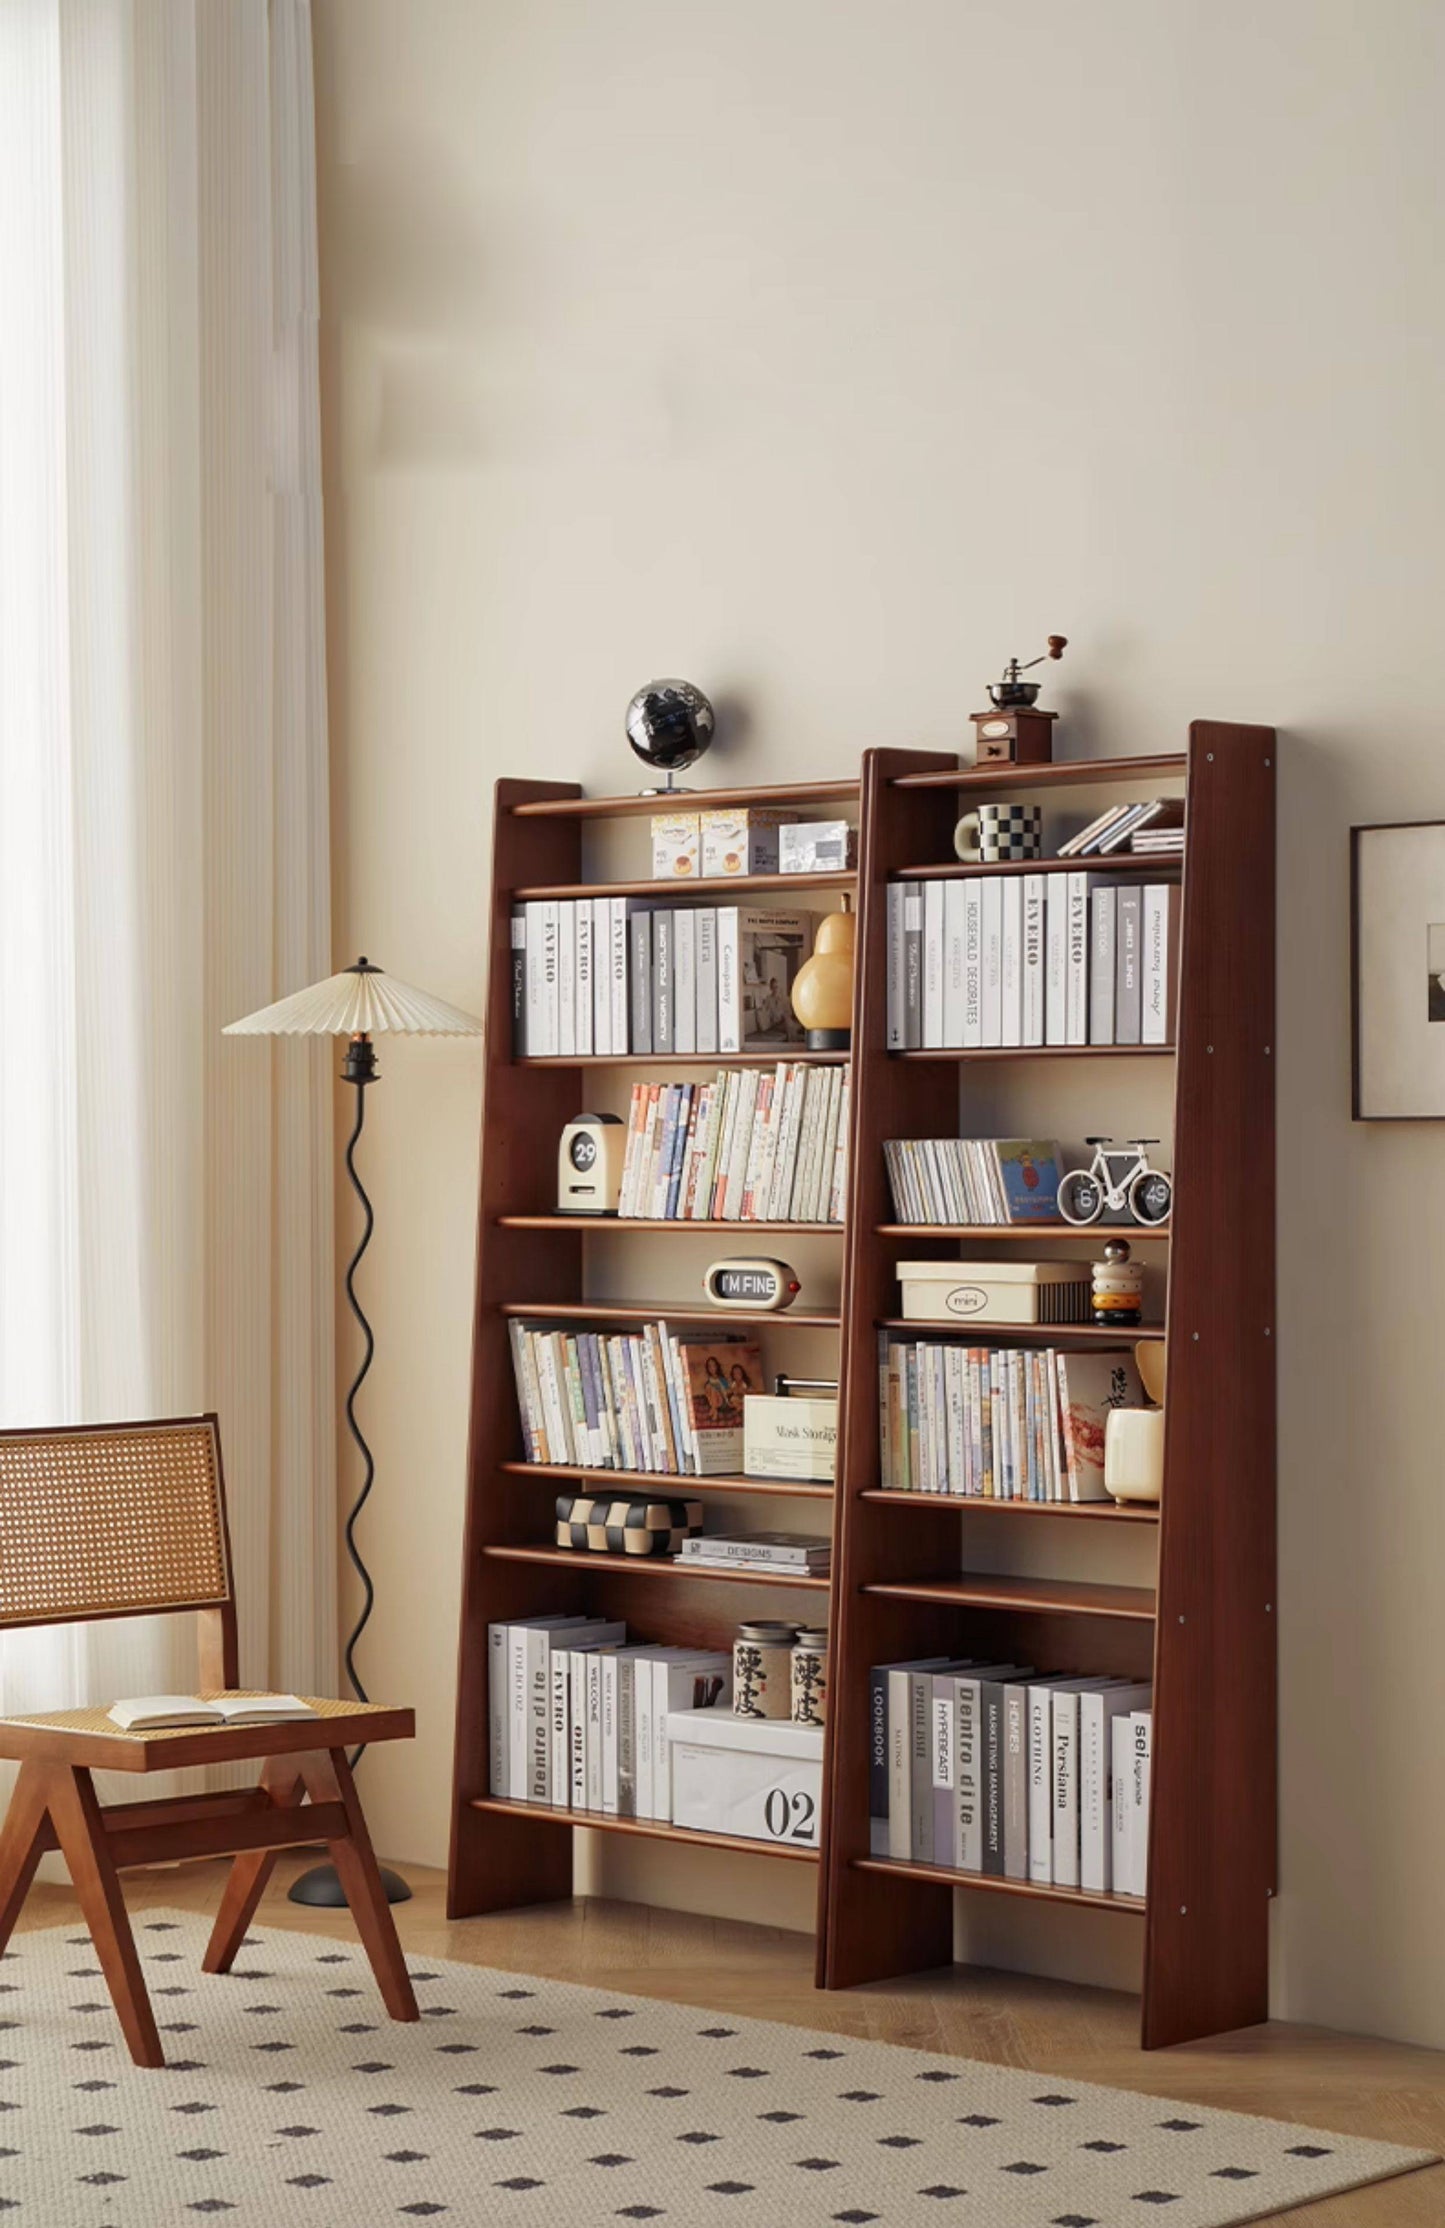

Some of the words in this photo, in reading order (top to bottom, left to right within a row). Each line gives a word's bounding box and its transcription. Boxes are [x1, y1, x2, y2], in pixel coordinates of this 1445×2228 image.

[967, 901, 977, 961] HOUSEHOLD
[1027, 898, 1038, 966] EVERO
[1071, 895, 1082, 965] EVERO
[721, 943, 732, 1005] Company
[966, 966, 977, 1026] DECORATES
[659, 993, 667, 1042] AURORA
[575, 1143, 596, 1162] 29
[1079, 1189, 1093, 1208] 6
[1145, 1184, 1168, 1204] 49
[722, 1275, 741, 1294] I'M
[742, 1275, 776, 1294] FINE
[953, 1292, 979, 1306] mini
[554, 1670, 563, 1733] EVERO
[590, 1666, 599, 1724] WELCOME
[573, 1725, 583, 1788] EVERO
[873, 1686, 884, 1767] LOOKBOOK
[937, 1702, 949, 1783] HYPEBEAST
[959, 1687, 974, 1765] Dentro
[989, 1704, 998, 1770] MARKETING
[1033, 1704, 1042, 1787] CLOTHING
[1134, 1724, 1149, 1759] sei
[533, 1731, 546, 1797] Dentro
[960, 1774, 974, 1799] di
[1057, 1733, 1071, 1810] Persiana
[763, 1787, 816, 1842] 02
[960, 1803, 974, 1826] te
[989, 1772, 998, 1853] MANAGEMENT
